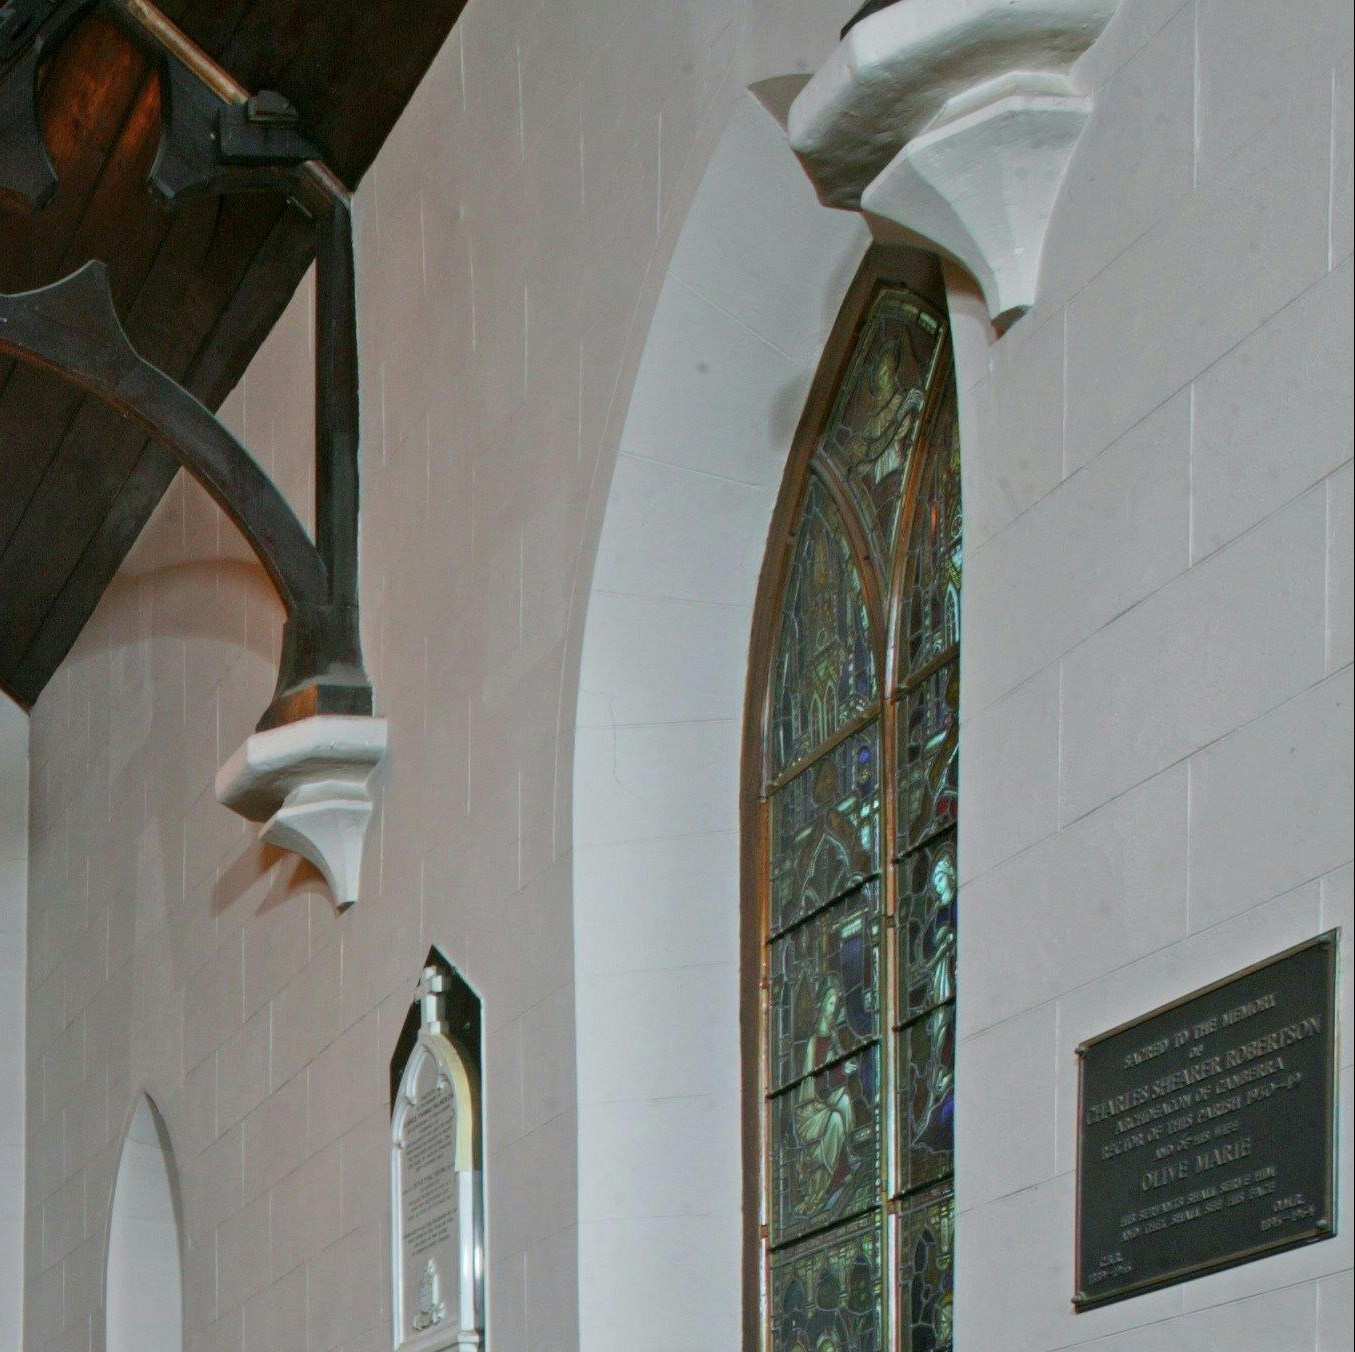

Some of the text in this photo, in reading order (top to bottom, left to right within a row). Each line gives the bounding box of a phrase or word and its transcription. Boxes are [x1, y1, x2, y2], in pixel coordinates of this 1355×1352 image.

[1124, 992, 1276, 1070] SACRED TO THE MEMORY
[1088, 1015, 1322, 1126] CHARLES SHEARER ROBERTSON
[1195, 1084, 1213, 1102] OF
[1215, 1056, 1285, 1095] CANBERRA
[1168, 1113, 1193, 1135] THIS
[1197, 1095, 1242, 1123] PARISH
[1141, 1137, 1251, 1192] OLIVE MARIE
